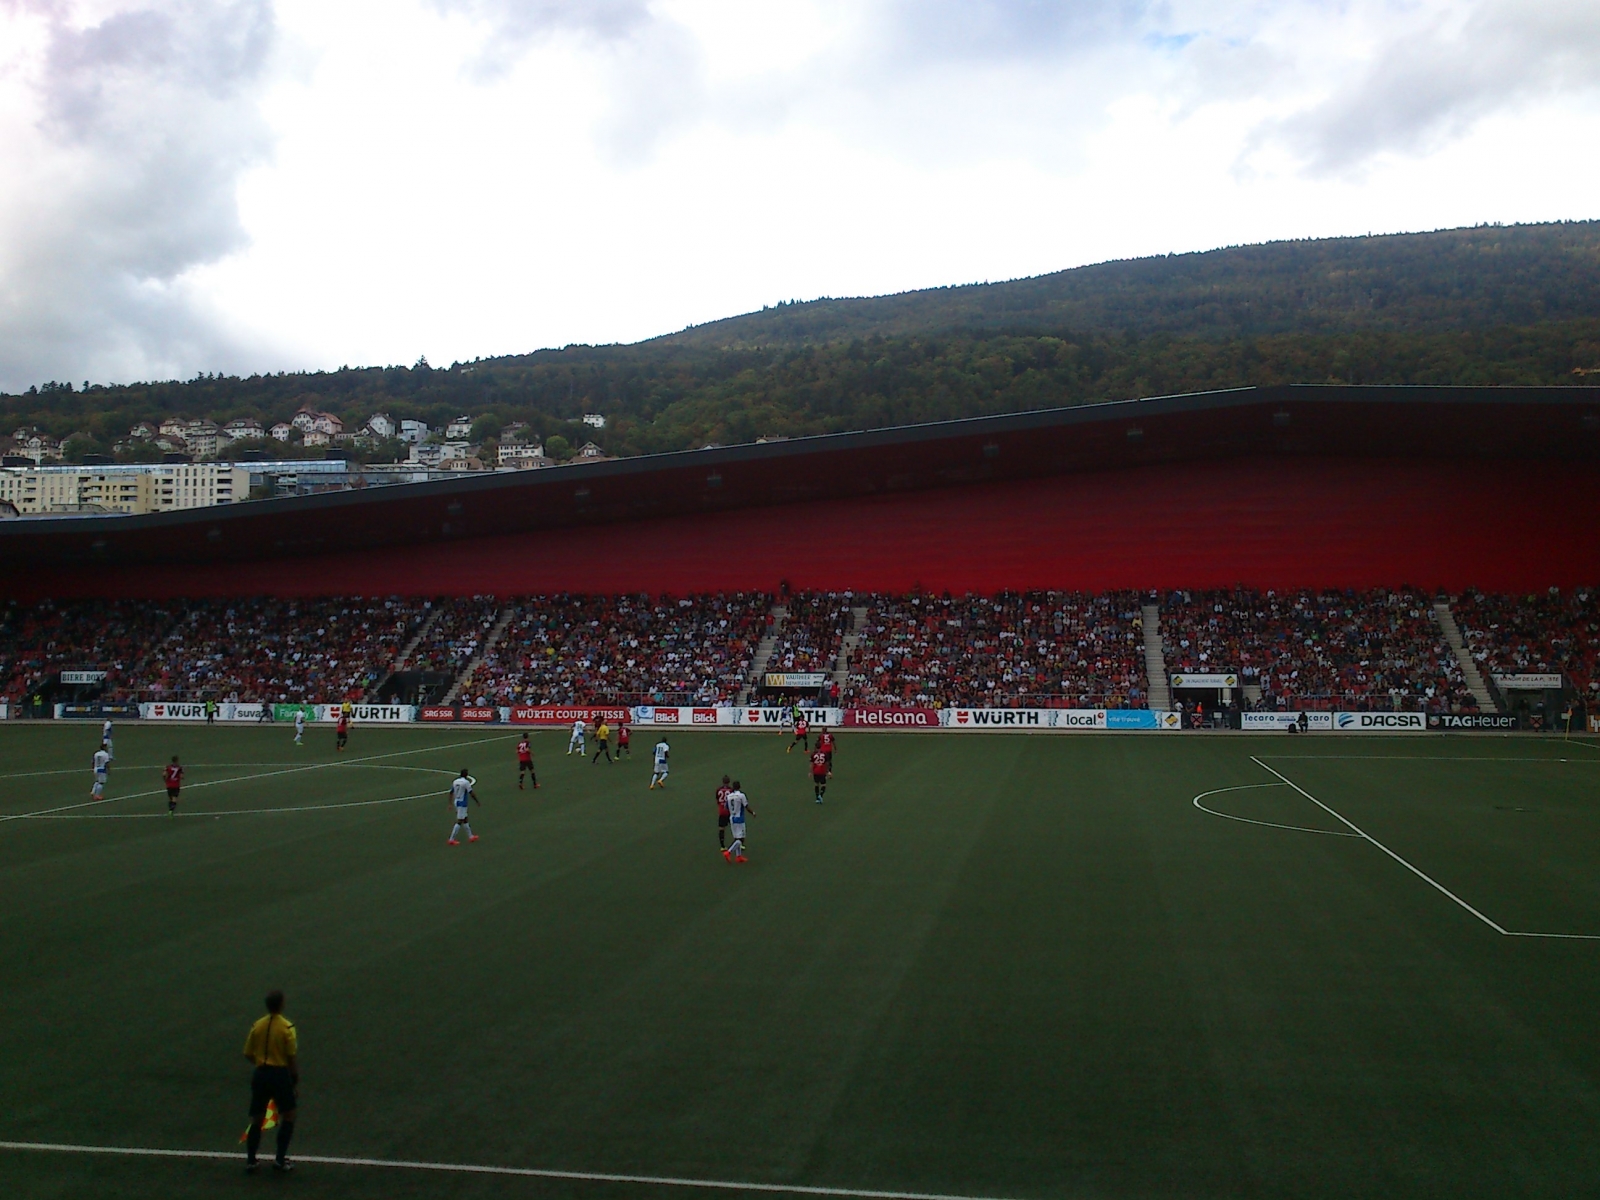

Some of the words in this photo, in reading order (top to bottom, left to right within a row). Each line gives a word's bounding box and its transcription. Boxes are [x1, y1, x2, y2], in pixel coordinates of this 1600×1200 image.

[517, 708, 553, 719] WÜRTH
[557, 709, 588, 719] COUPE
[655, 711, 679, 723] Blick
[693, 711, 717, 723] Blick
[763, 710, 826, 723] WTH
[855, 710, 927, 725] Helsana
[973, 711, 1039, 724] WÜRTH
[1243, 713, 1275, 722] Tecaro
[1361, 715, 1422, 727] DACSA
[813, 754, 825, 764] 25
[171, 767, 178, 779] 7
